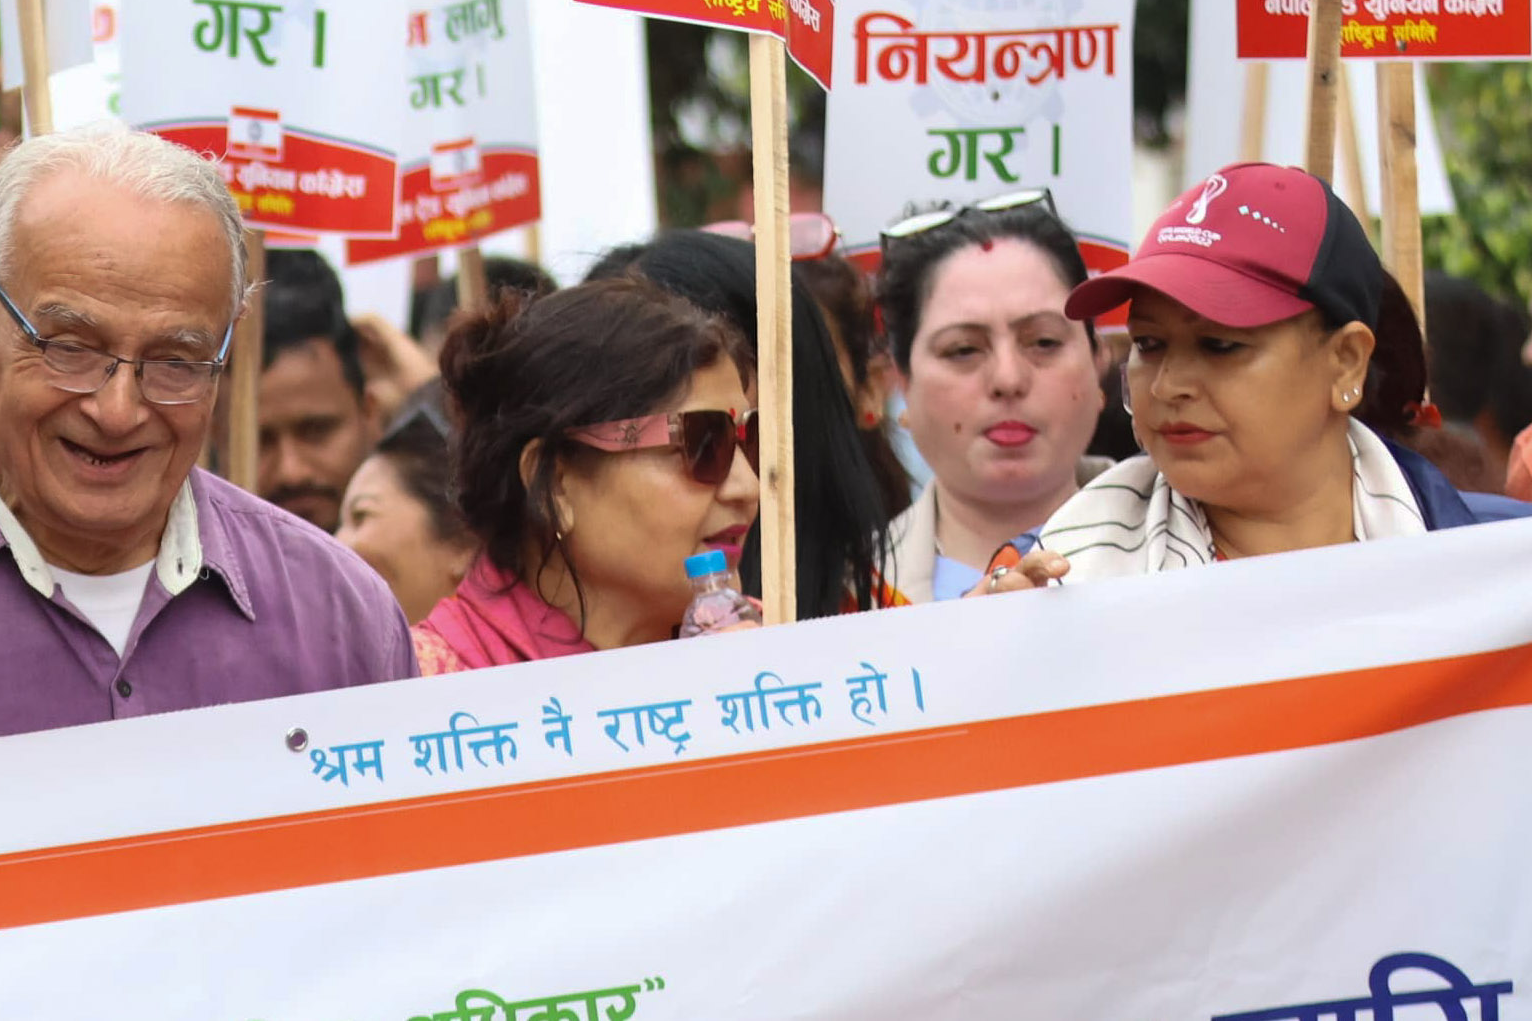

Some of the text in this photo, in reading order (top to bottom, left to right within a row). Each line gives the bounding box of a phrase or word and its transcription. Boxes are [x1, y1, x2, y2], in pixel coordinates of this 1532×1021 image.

[852, 10, 1120, 86] नियन्त्रण
[308, 738, 386, 788] श्रम
[408, 712, 520, 774] शक्ति
[542, 696, 574, 756] नै
[715, 670, 824, 731] शक्ति
